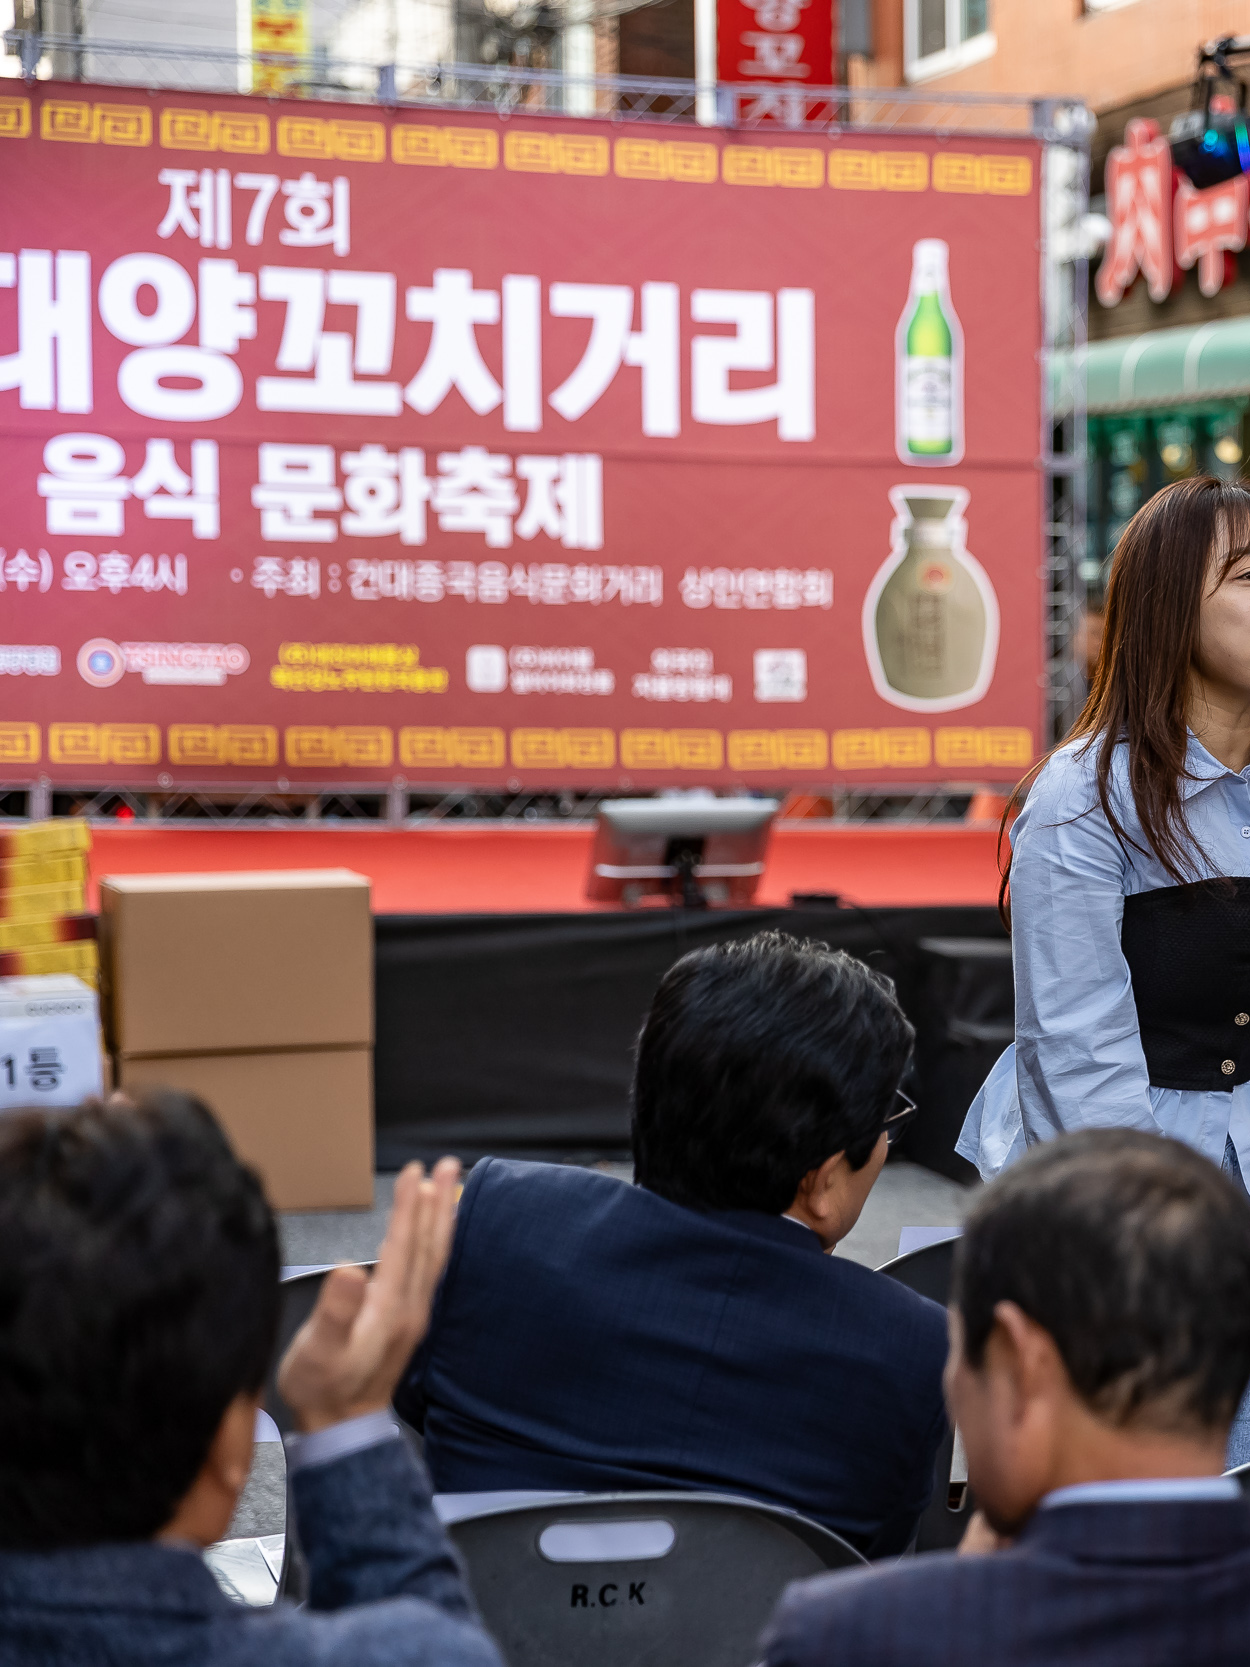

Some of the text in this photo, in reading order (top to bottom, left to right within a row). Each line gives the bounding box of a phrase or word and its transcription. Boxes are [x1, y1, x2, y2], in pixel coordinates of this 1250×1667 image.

[157, 167, 350, 257] 제7회
[0, 247, 816, 442] 대양꼬치거리
[36, 431, 605, 551] 음식 문화축제
[61, 549, 189, 597] 오후4시
[251, 555, 321, 599] 주최
[346, 556, 664, 607] 건대중국음식문화거리
[2, 1046, 68, 1092] 1등
